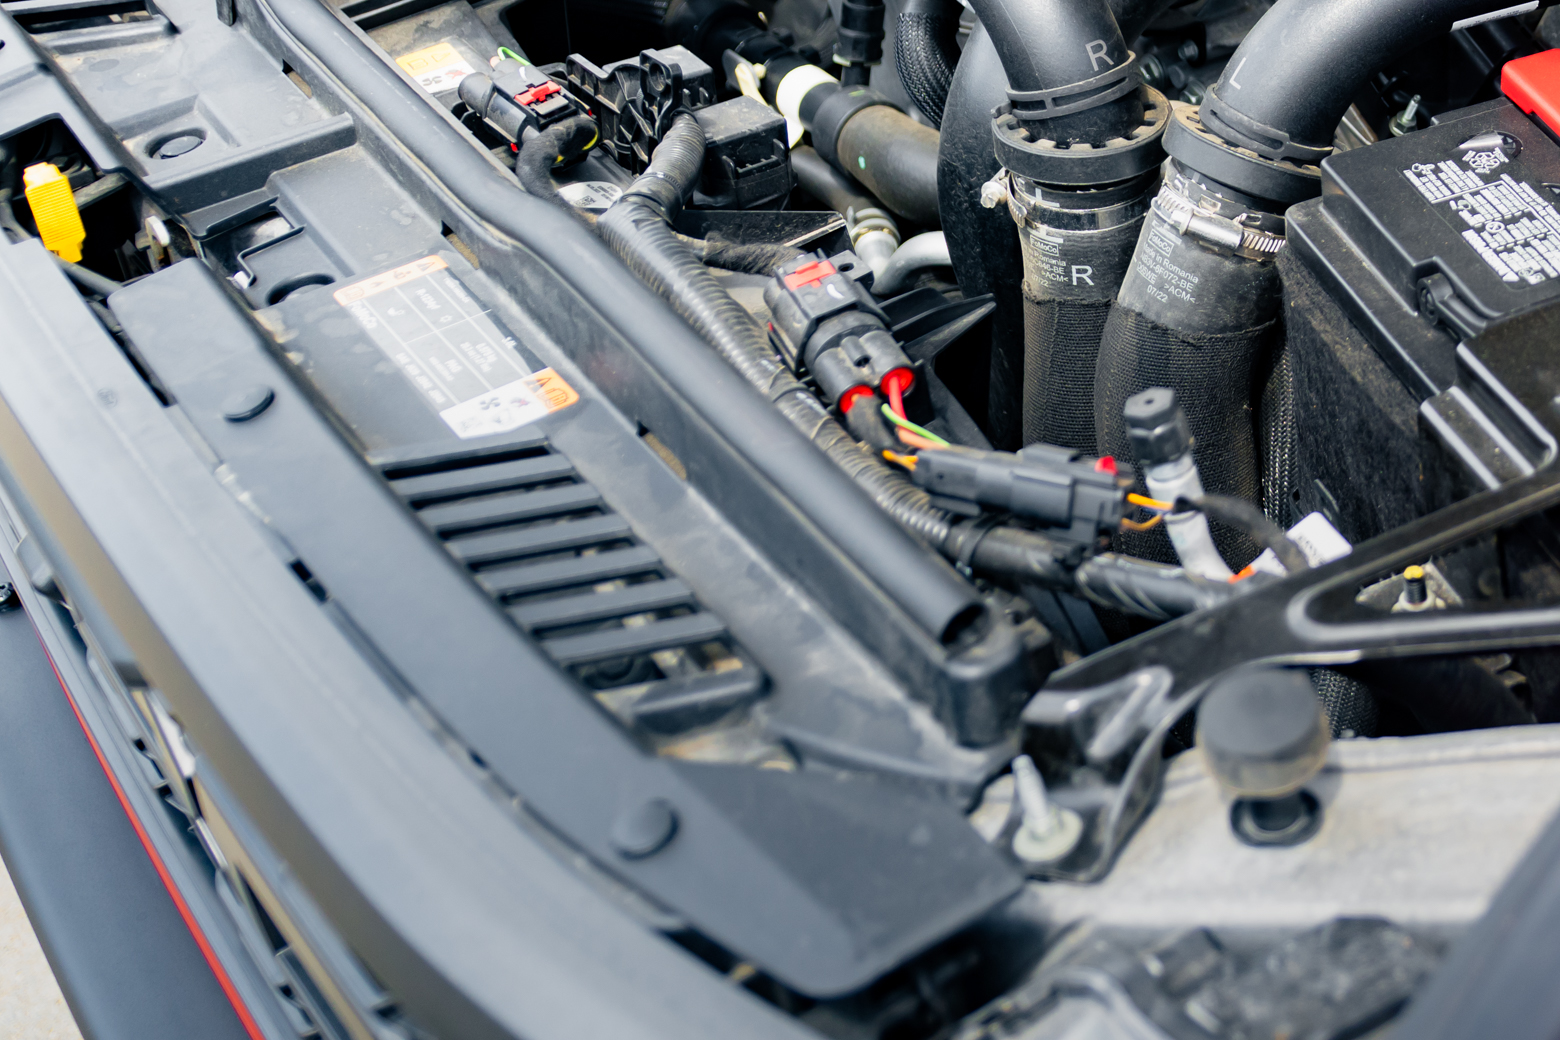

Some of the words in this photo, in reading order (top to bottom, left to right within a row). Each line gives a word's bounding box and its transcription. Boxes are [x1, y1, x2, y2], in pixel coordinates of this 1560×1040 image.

[1085, 39, 1114, 71] R
[1229, 57, 1247, 89] L
[1031, 238, 1058, 253] FoMoCo
[1149, 230, 1172, 254] FoMoCo
[1034, 251, 1066, 266] Romania
[1155, 253, 1163, 263] in
[1162, 258, 1199, 284] Romania
[1072, 265, 1095, 286] R
[1147, 284, 1168, 303] 07/22
[347, 300, 378, 329] FoMoCo
